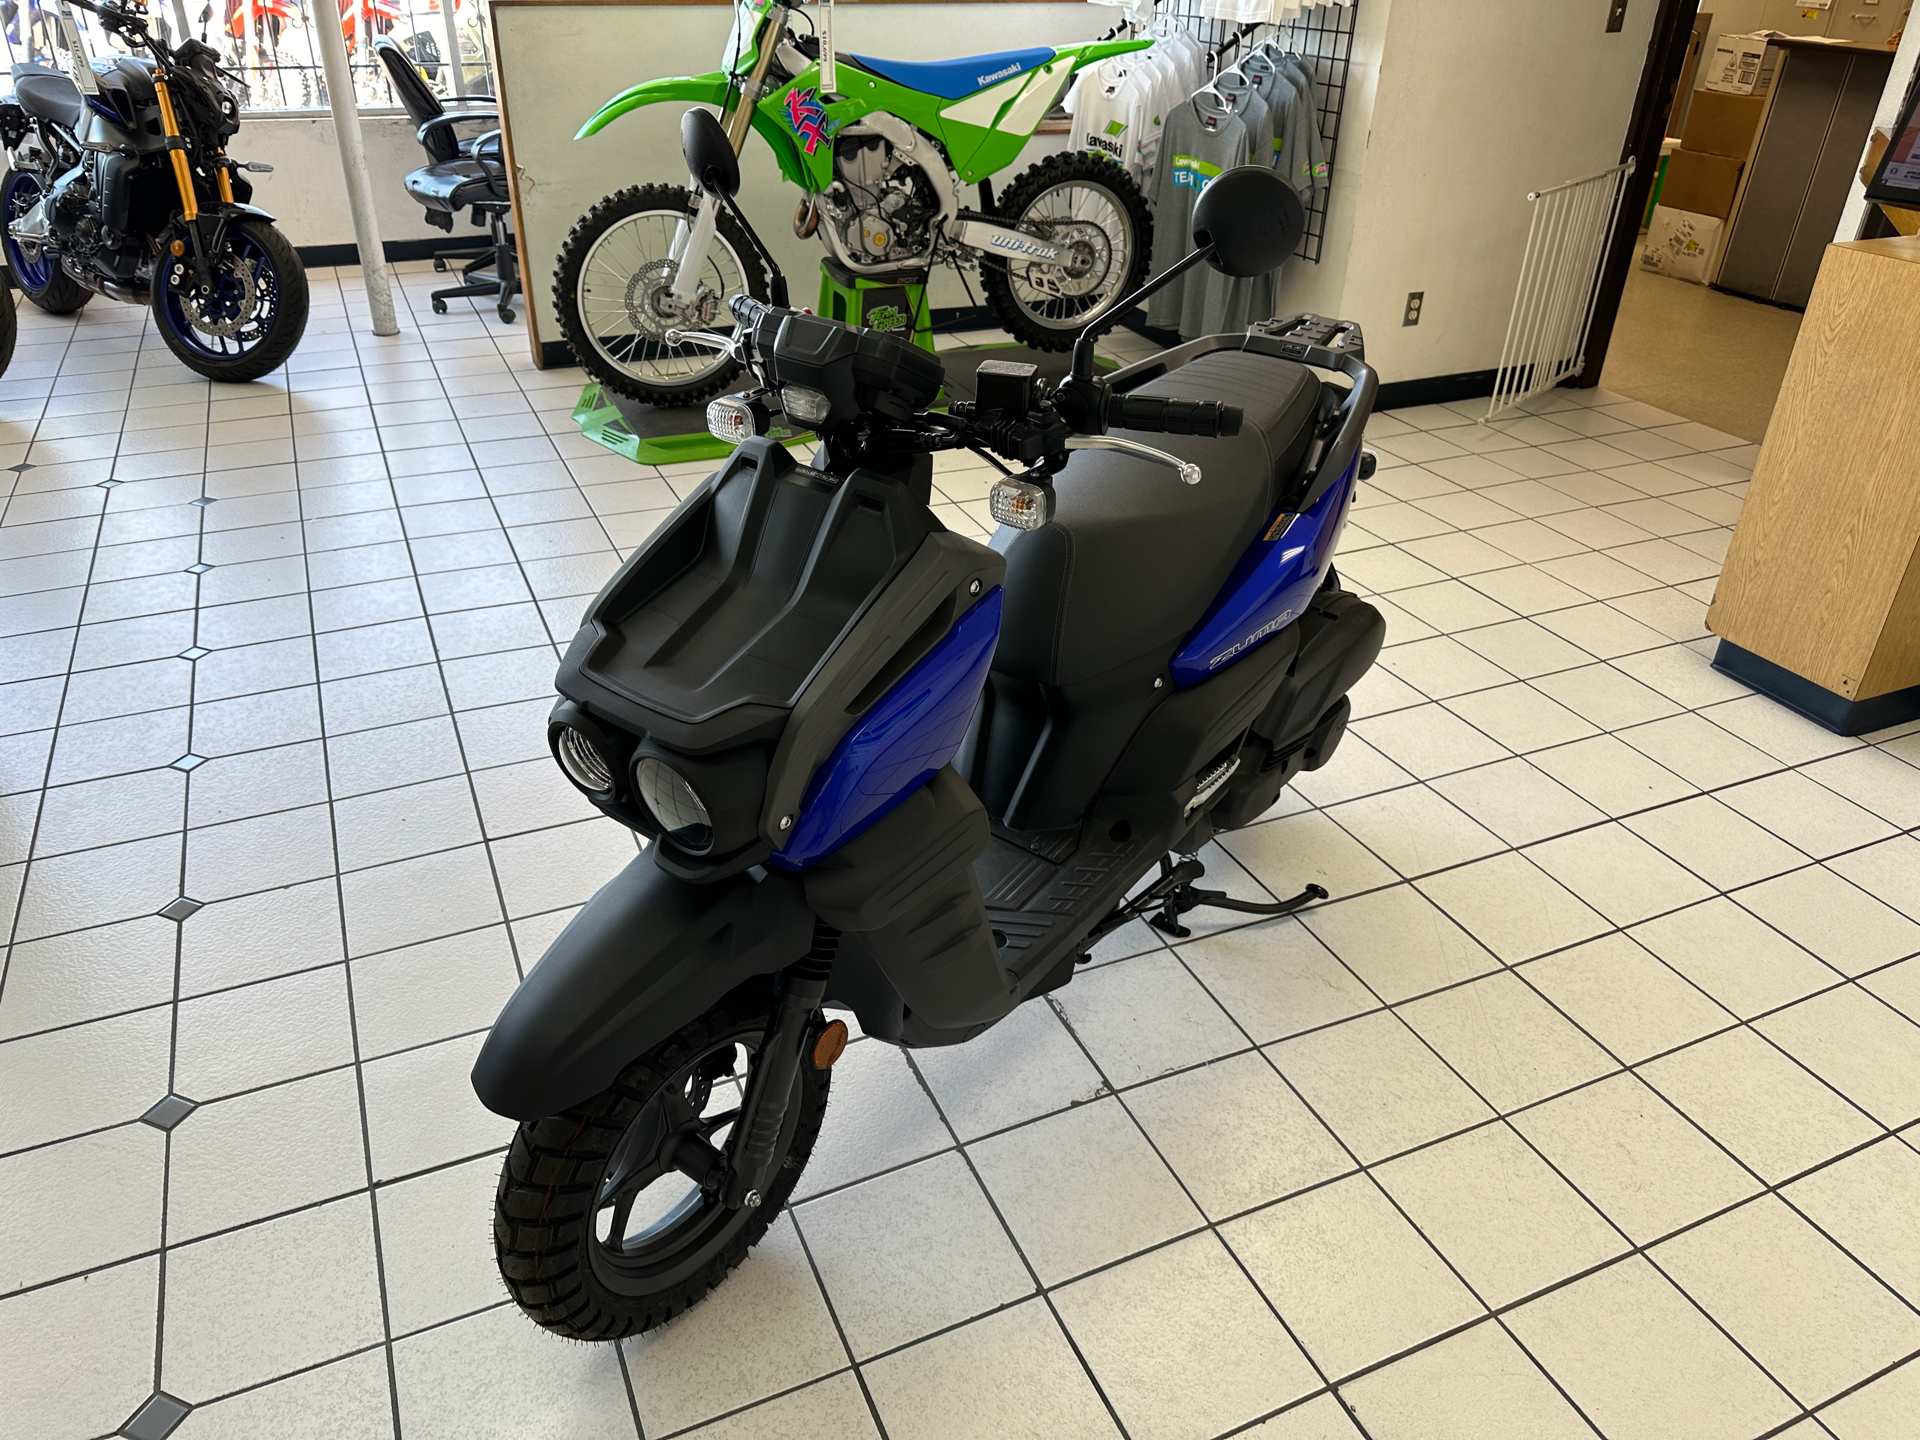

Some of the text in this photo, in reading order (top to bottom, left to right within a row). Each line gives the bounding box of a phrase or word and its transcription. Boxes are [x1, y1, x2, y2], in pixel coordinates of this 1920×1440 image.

[977, 62, 1021, 86] Kawasaki
[991, 235, 1059, 260] uni-trak
[867, 305, 898, 325] TEAM
[873, 313, 907, 332] GREEN
